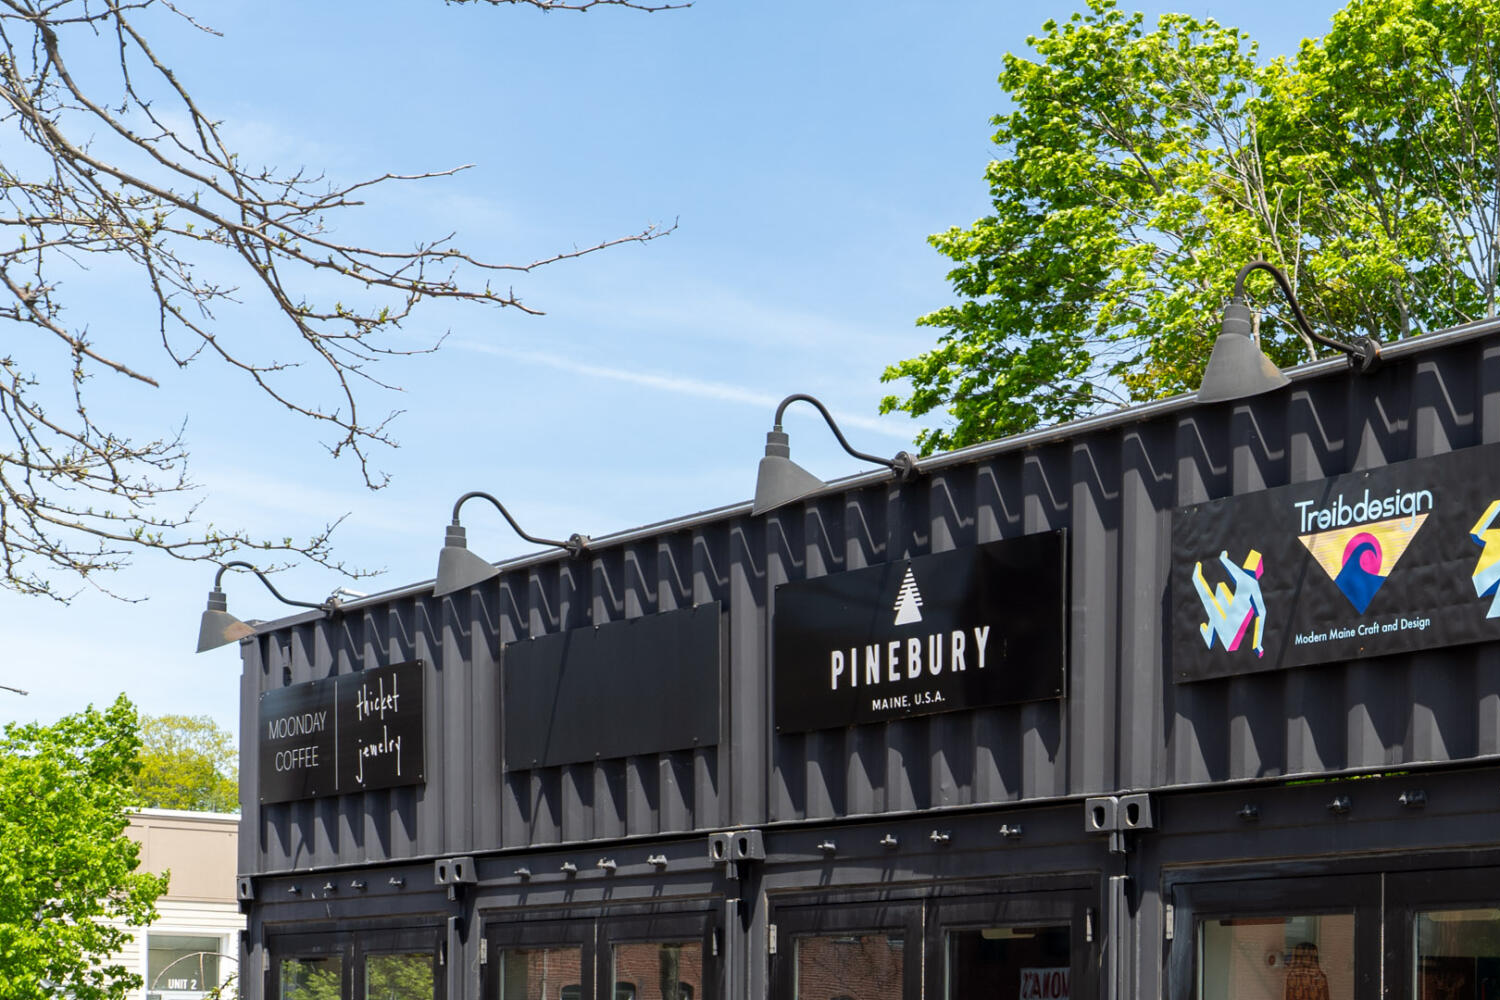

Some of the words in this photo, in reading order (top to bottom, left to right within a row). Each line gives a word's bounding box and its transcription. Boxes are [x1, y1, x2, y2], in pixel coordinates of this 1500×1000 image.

[1294, 488, 1434, 532] Treibdesign
[1295, 632, 1328, 646] Modern
[1328, 628, 1356, 642] Maine
[1357, 622, 1380, 638] Craft
[1381, 620, 1398, 633] and
[1400, 616, 1431, 632] Design
[830, 625, 991, 691] PINEBURY
[356, 672, 400, 722] thicket
[914, 690, 946, 706] U.S.A.
[268, 710, 327, 740] MOONDAY
[275, 745, 319, 772] COFFEE
[355, 724, 401, 783] jewelry
[168, 978, 187, 990] UNIT
[190, 978, 198, 990] 2
